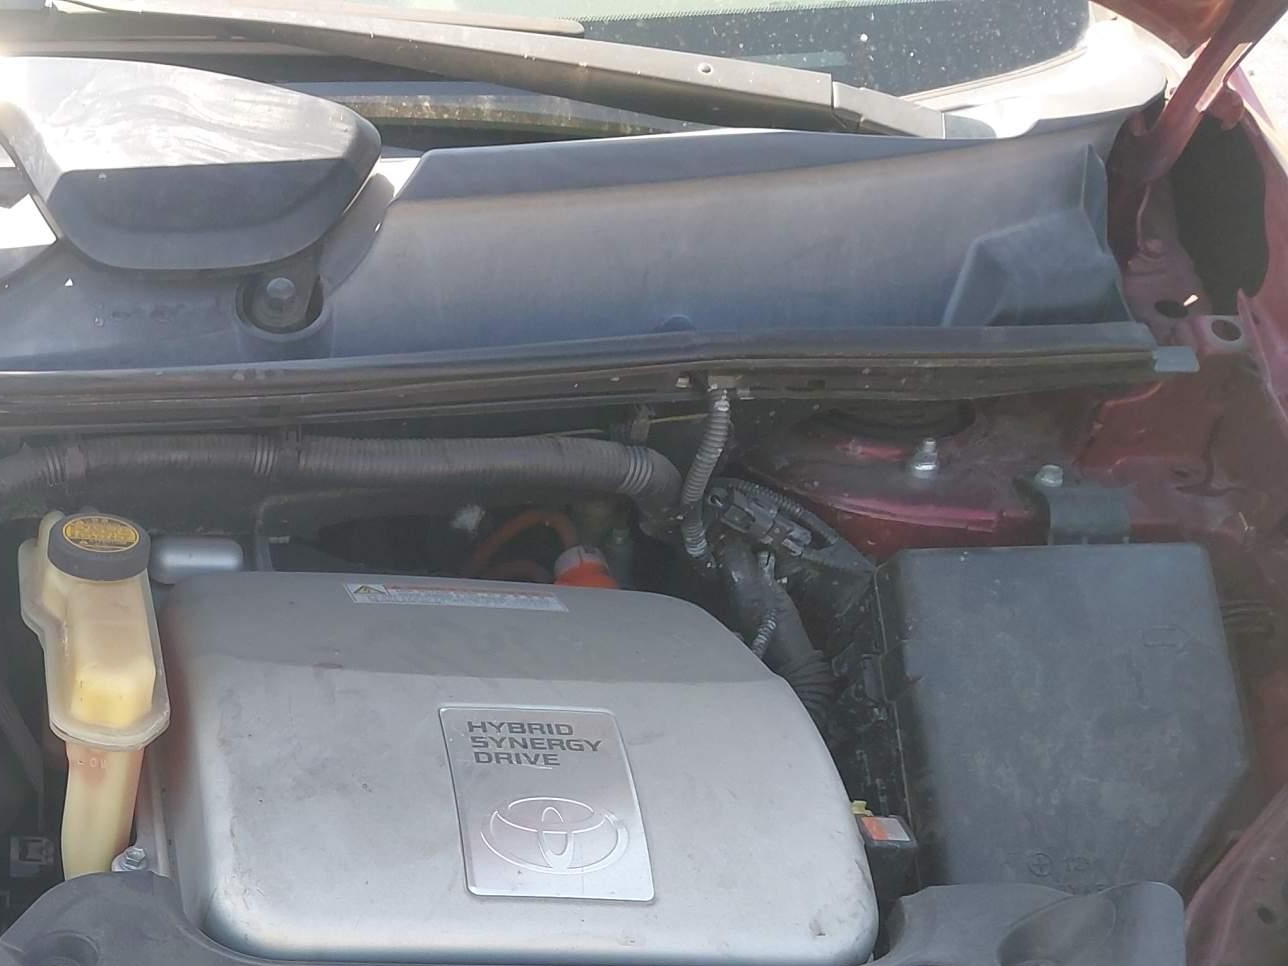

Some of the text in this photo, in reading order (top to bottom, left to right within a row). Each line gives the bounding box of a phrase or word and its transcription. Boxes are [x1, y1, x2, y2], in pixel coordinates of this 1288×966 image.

[466, 720, 574, 736] HYBRID
[470, 735, 603, 752] SYNERGY
[473, 751, 561, 767] DRIVE
